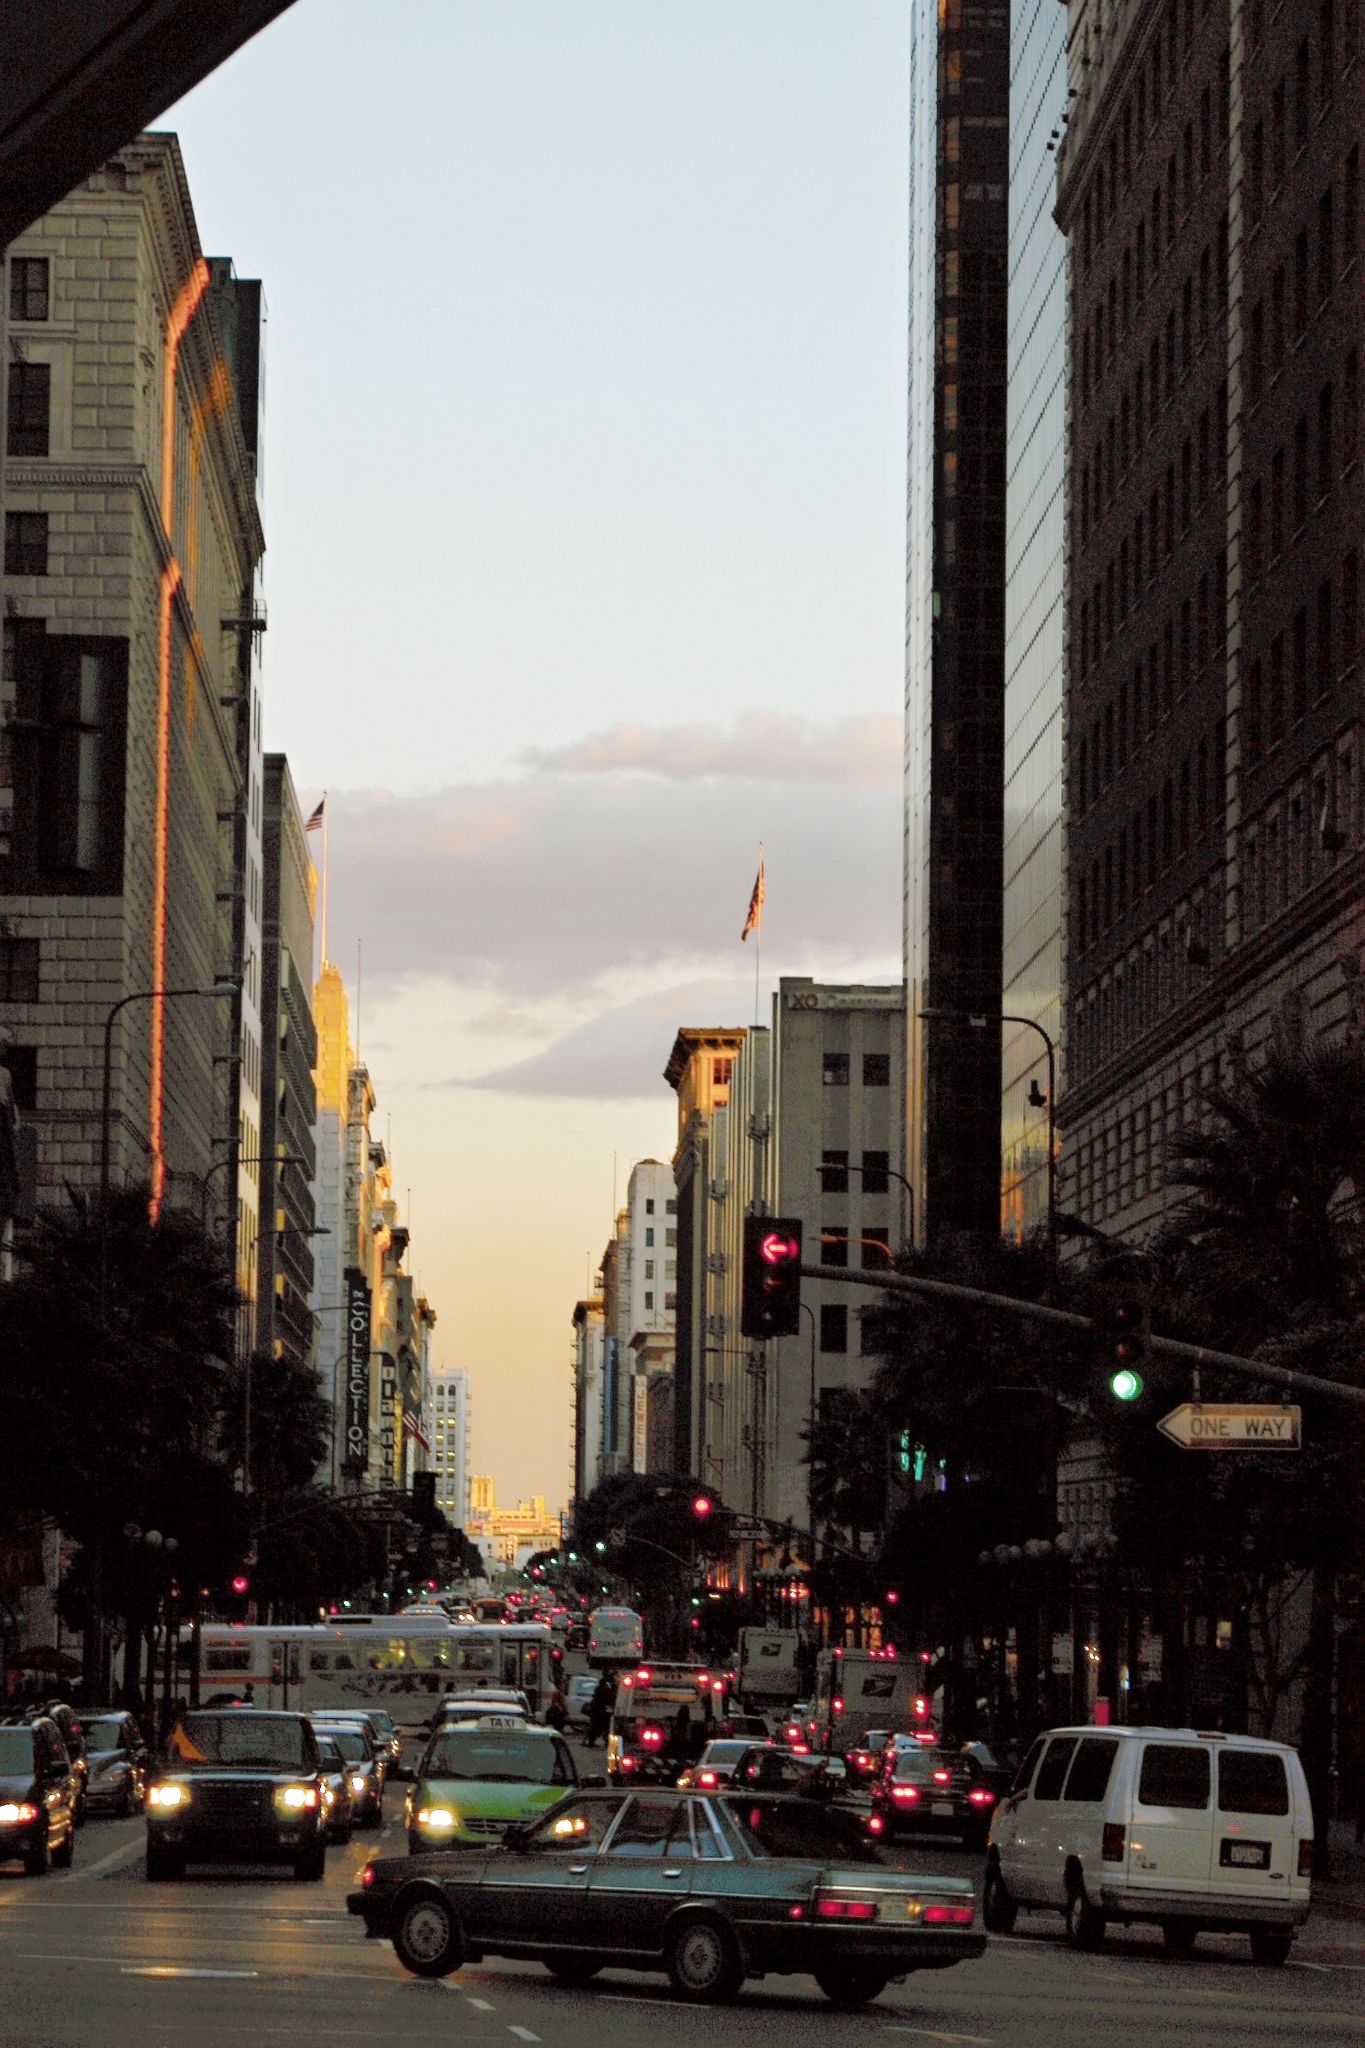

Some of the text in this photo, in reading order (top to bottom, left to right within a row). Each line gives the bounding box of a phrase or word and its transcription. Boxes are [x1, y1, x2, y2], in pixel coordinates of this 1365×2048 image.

[793, 993, 818, 1008] XO
[348, 1301, 365, 1456] COLLECTION
[1190, 1418, 1286, 1437] ONE WAY
[490, 1717, 515, 1729] TAXI
